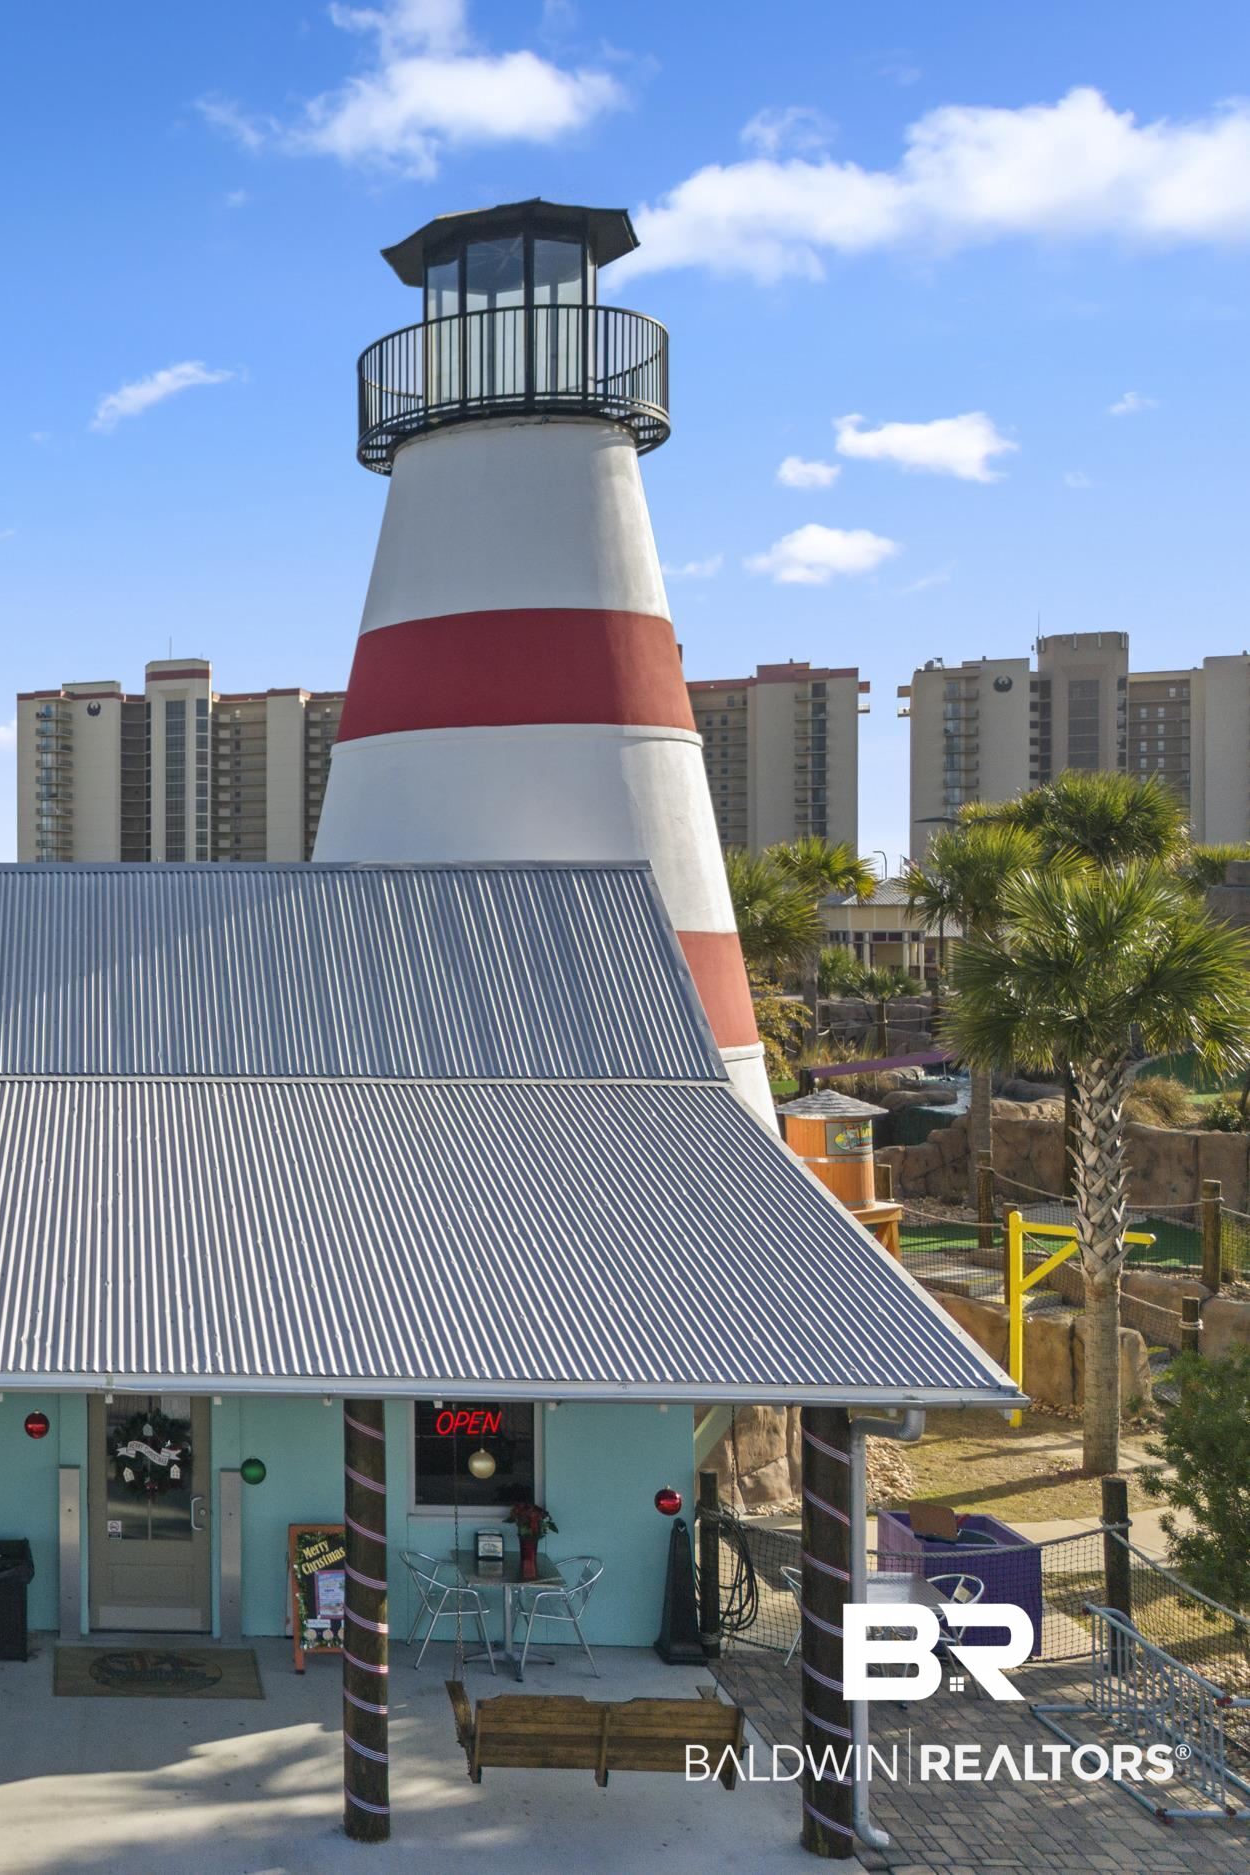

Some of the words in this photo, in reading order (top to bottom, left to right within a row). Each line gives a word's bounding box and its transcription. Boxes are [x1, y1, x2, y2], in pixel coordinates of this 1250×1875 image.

[436, 1410, 502, 1435] OPEN
[301, 1546, 346, 1575] Christmas
[302, 1540, 329, 1560] Merry
